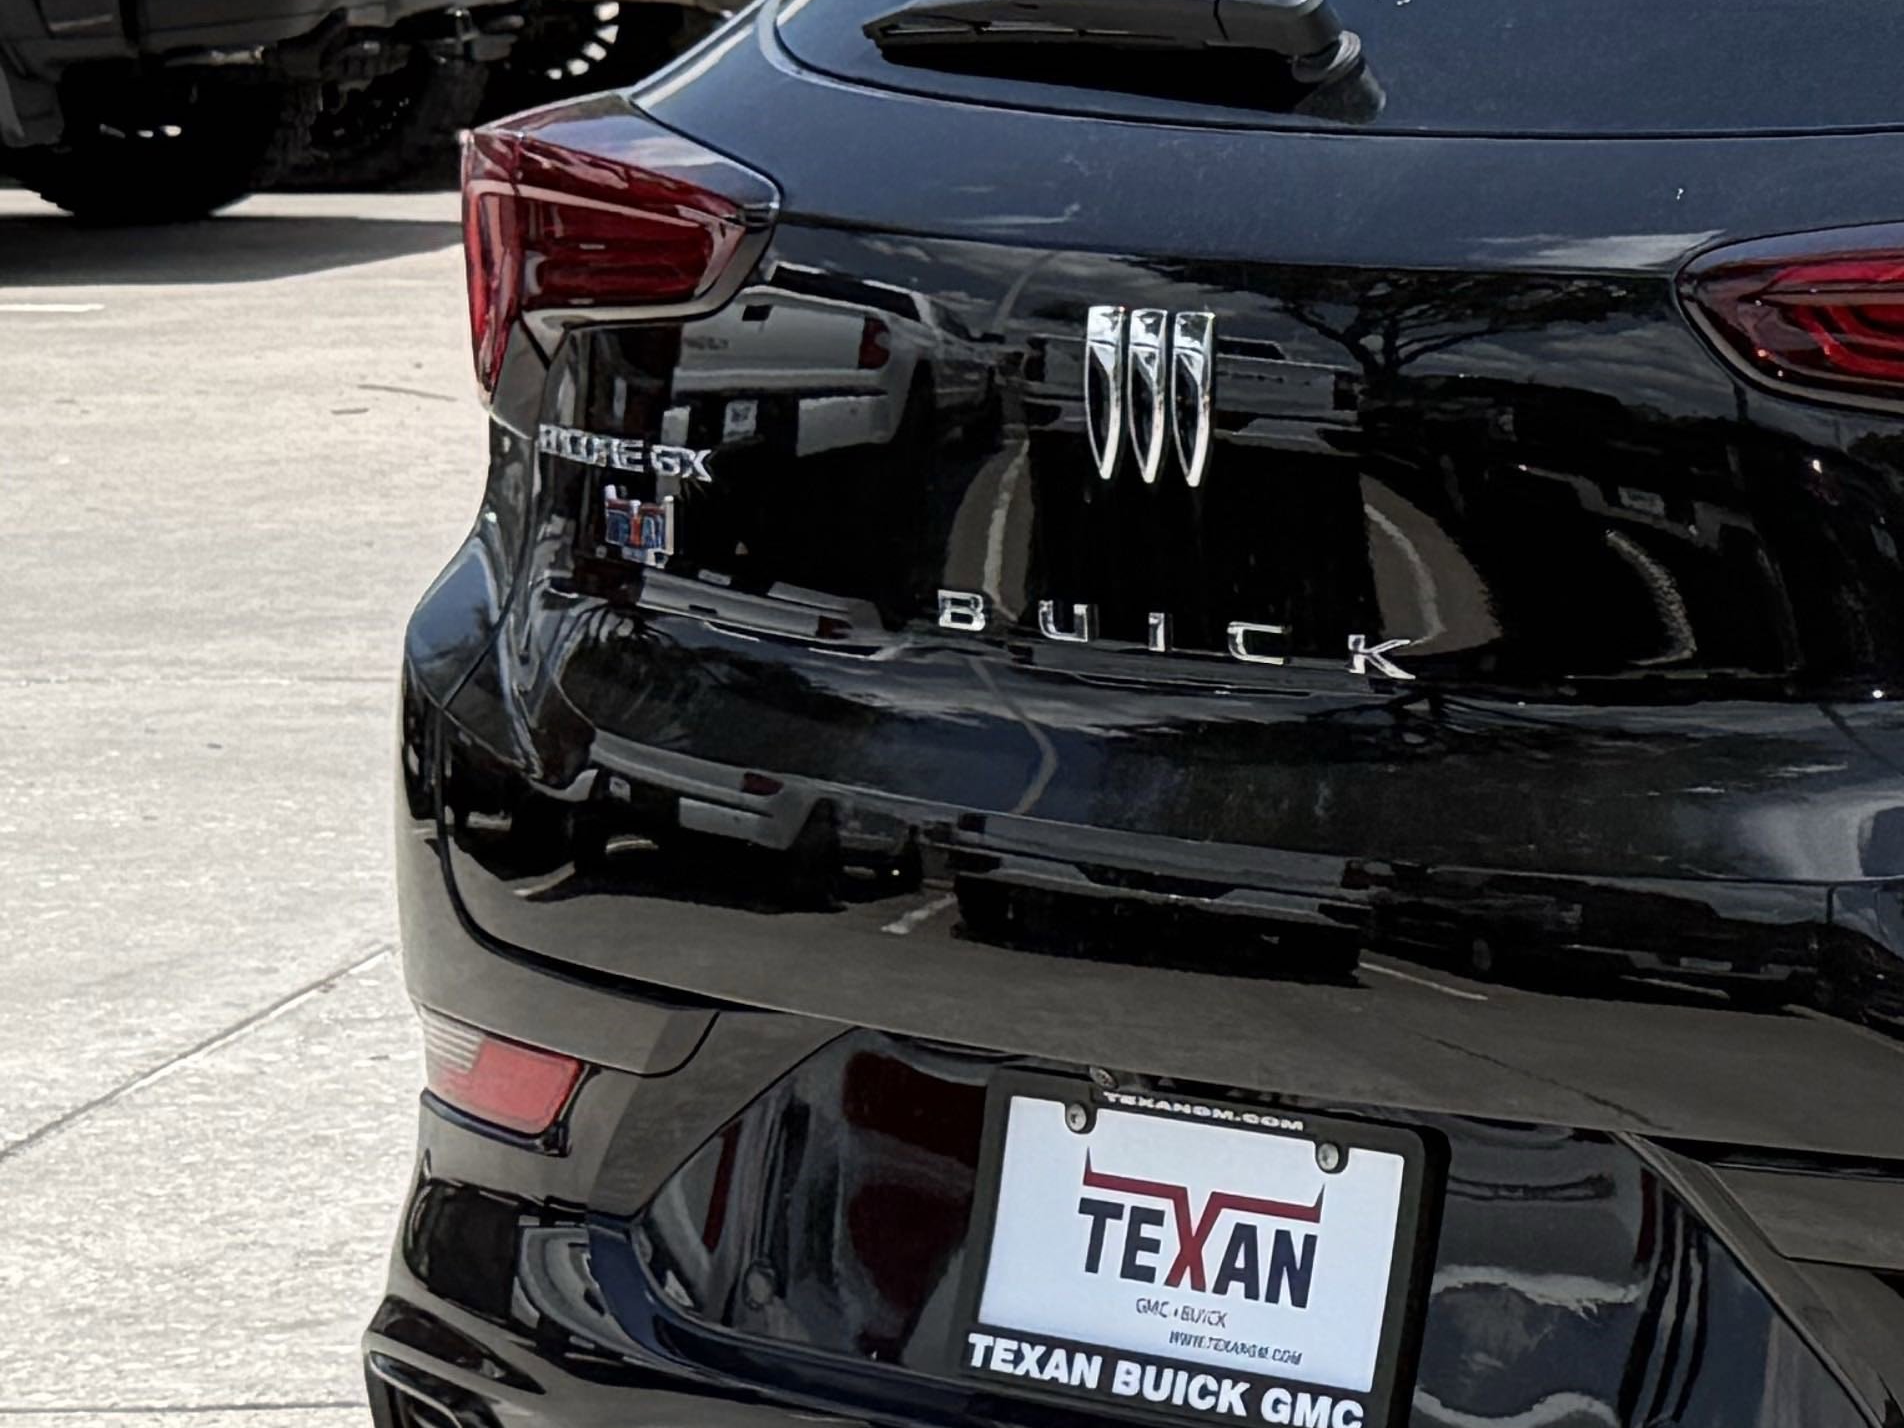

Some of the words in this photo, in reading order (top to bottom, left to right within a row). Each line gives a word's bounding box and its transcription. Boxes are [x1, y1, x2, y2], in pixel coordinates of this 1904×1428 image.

[937, 588, 1416, 680] BUICK
[1078, 1146, 1325, 1310] TEXAN
[968, 1332, 1102, 1390] TEXAN
[1112, 1361, 1251, 1417] BUICK
